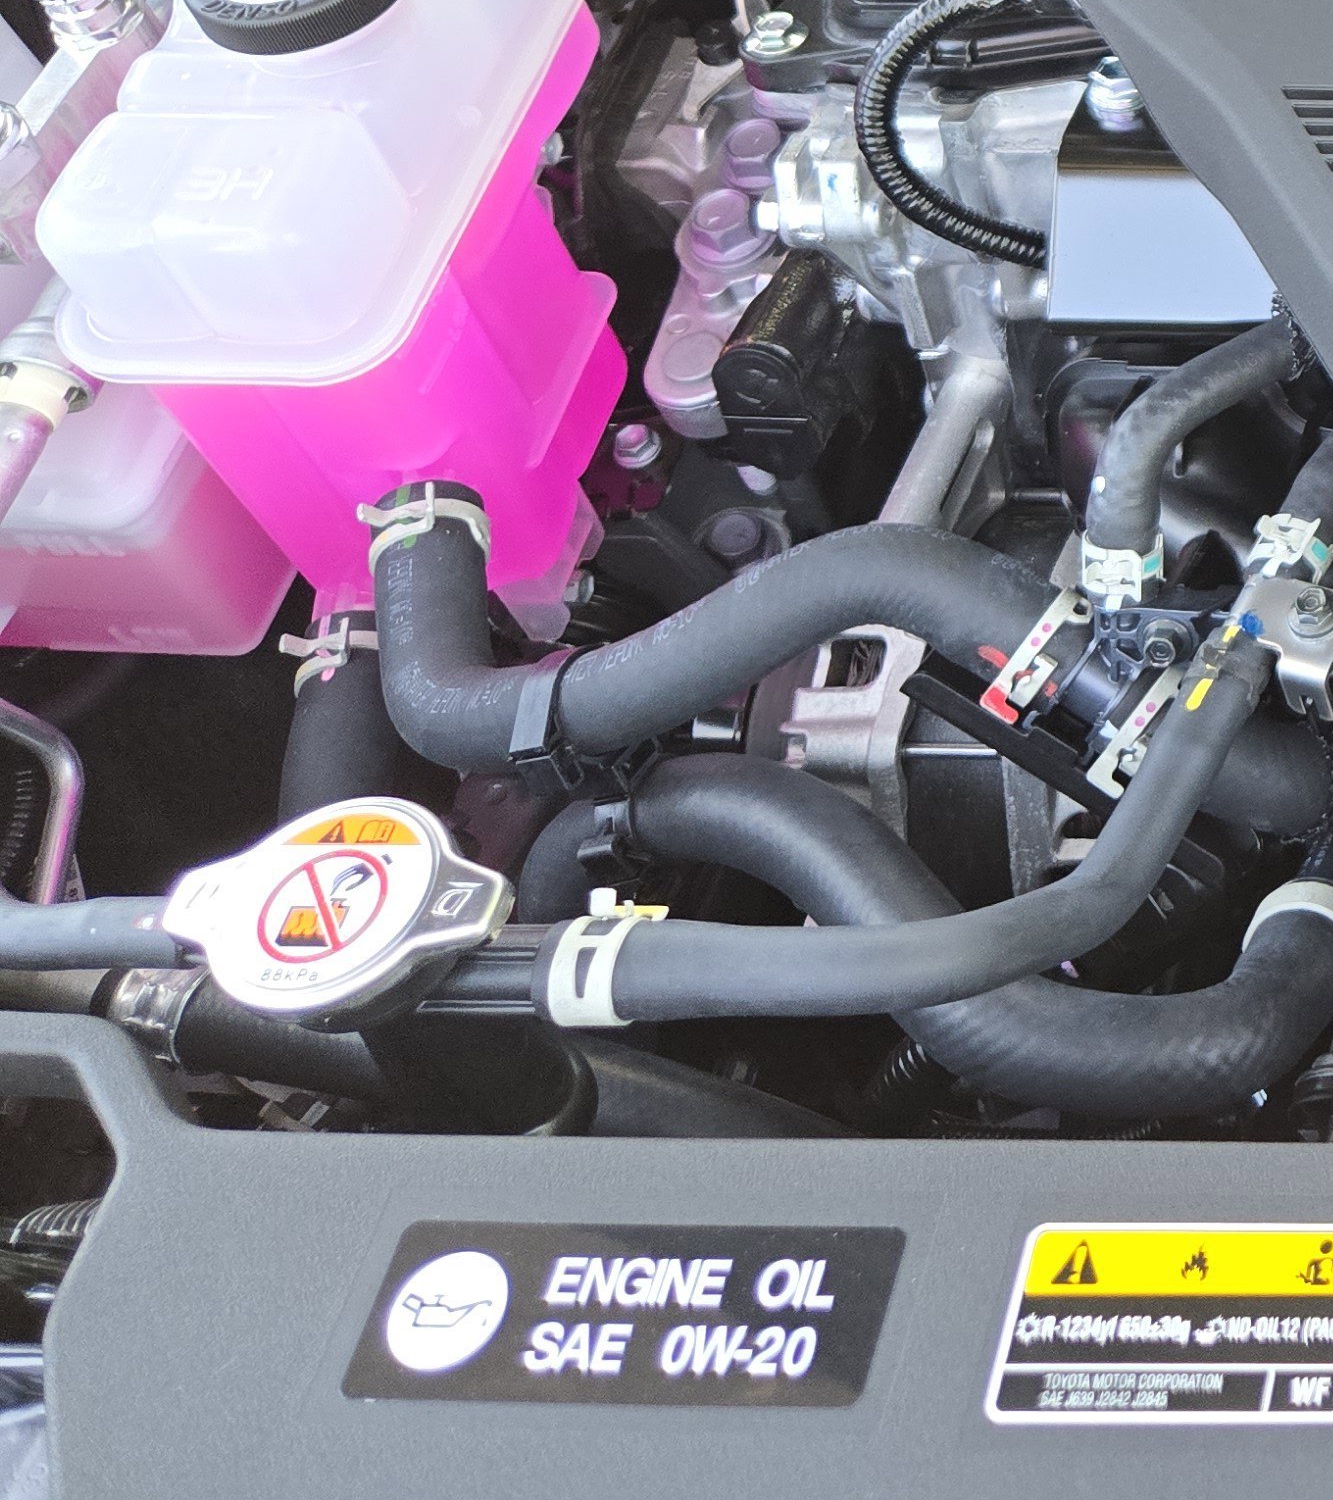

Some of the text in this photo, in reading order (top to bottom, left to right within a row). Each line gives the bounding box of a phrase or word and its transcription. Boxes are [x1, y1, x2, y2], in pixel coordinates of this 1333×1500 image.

[260, 967, 319, 982] 88kPa
[543, 1256, 836, 1310] ENGINE OIL
[523, 1321, 818, 1376] SAE 0W-20
[1044, 1374, 1224, 1393] TOYOTA MOTOR CORPORATION
[1290, 1377, 1332, 1407] WF
